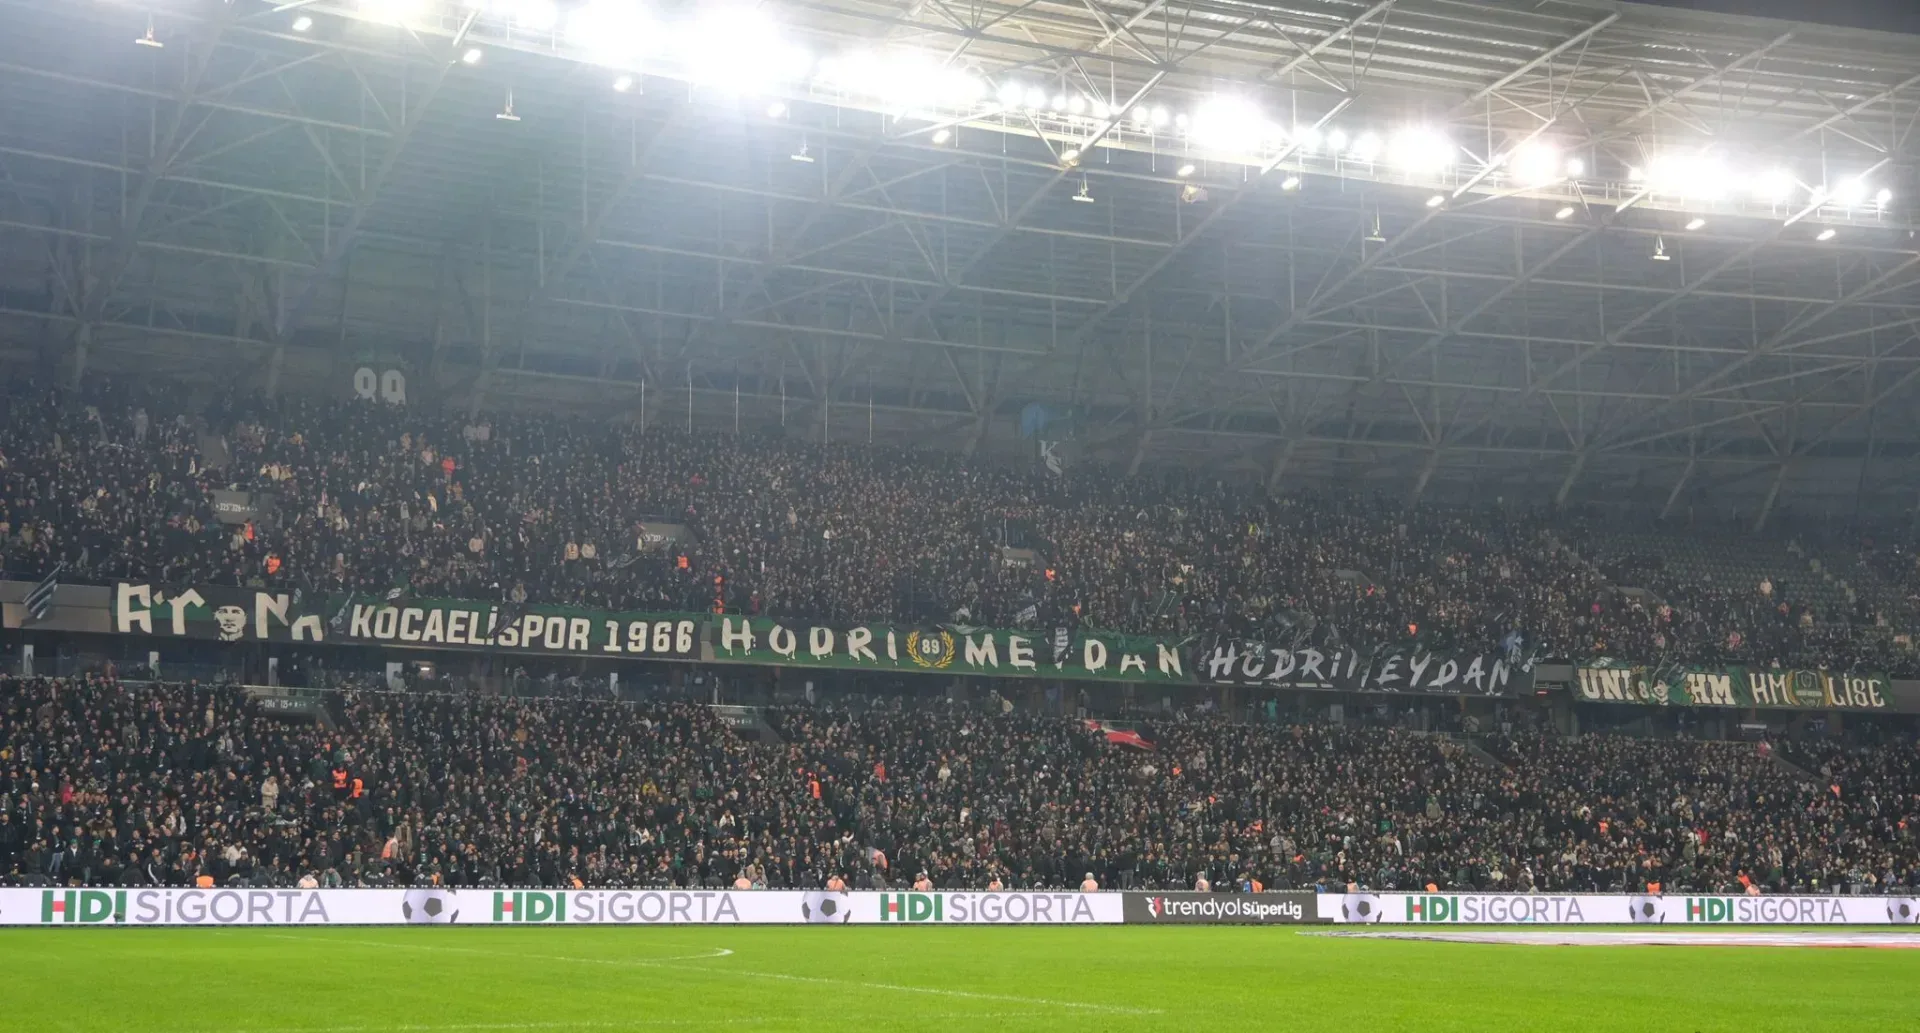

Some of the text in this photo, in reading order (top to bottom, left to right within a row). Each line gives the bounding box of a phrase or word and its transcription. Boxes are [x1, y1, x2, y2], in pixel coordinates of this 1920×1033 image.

[603, 620, 695, 653] 1966
[921, 638, 940, 655] 89
[964, 633, 1183, 679] MEDAN
[1688, 673, 1736, 704] HM
[1750, 673, 1792, 705] HM
[41, 890, 127, 923] HDI
[492, 892, 566, 922] HDI
[880, 893, 943, 921] HDI
[1163, 896, 1241, 919] trendyol
[1406, 896, 1458, 921] HDI
[1686, 897, 1734, 922] HDI
